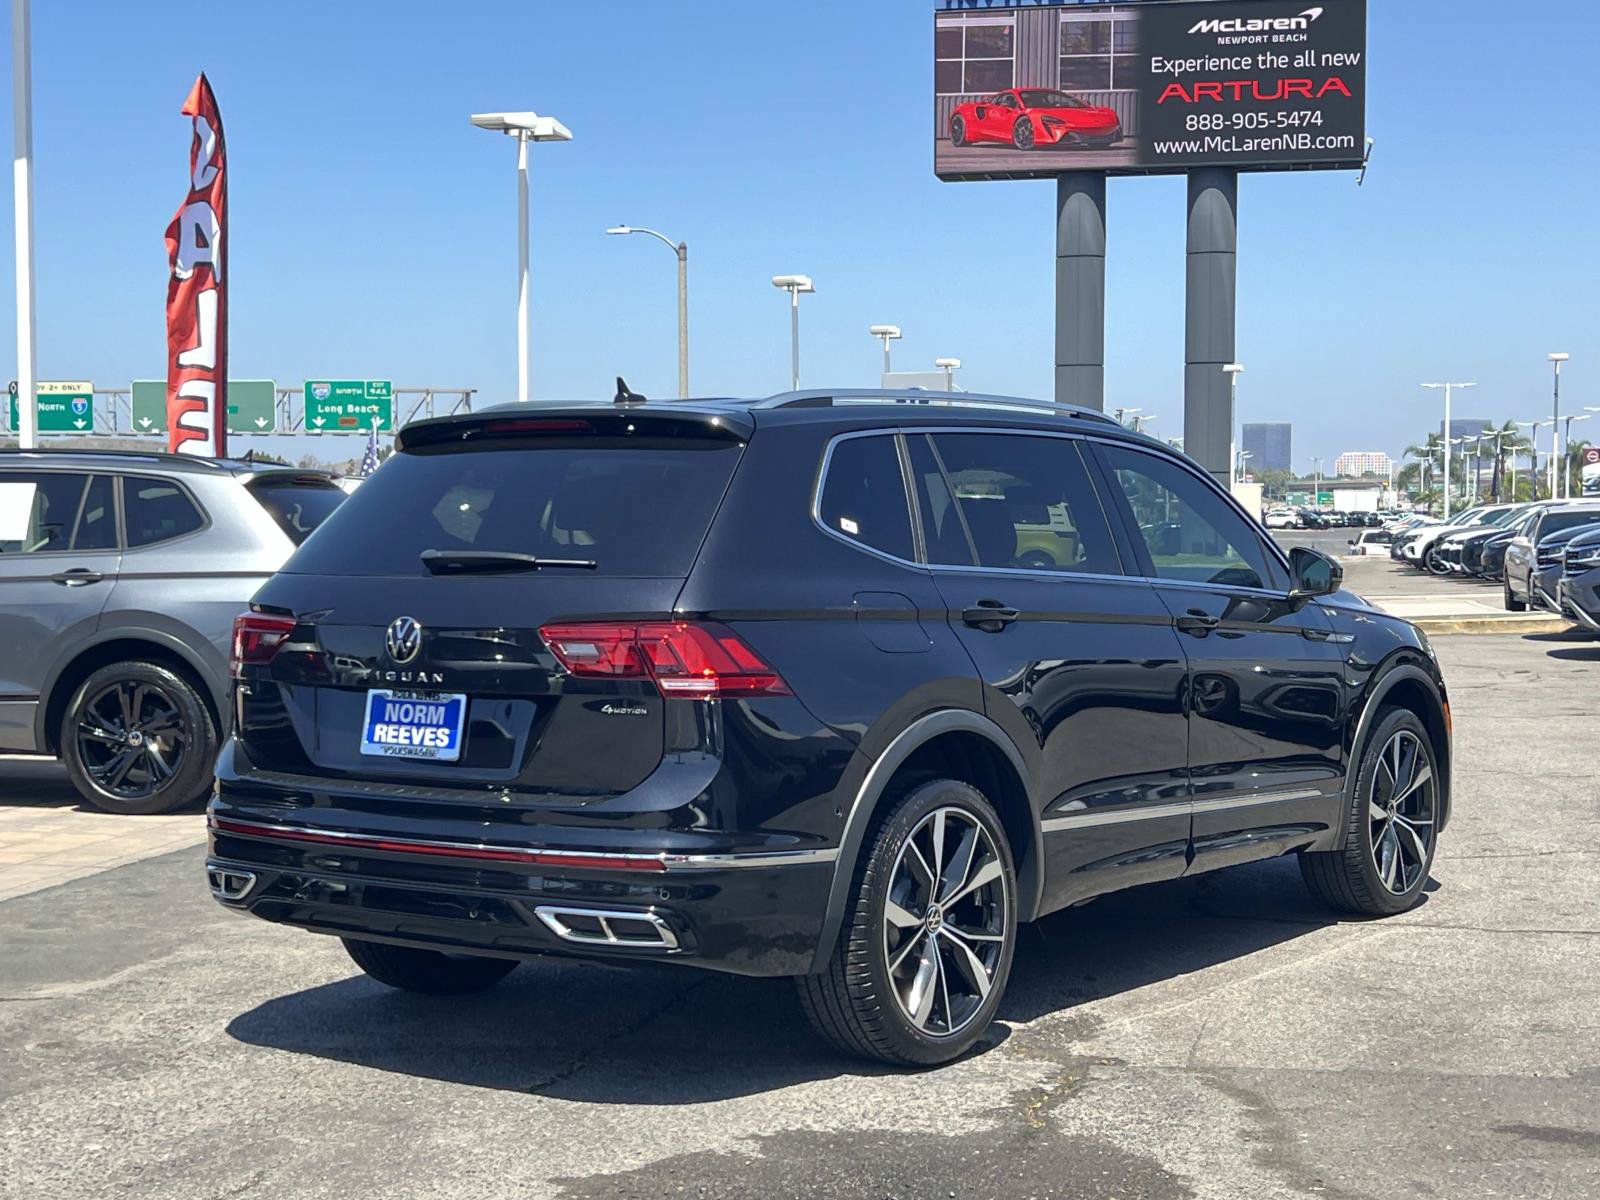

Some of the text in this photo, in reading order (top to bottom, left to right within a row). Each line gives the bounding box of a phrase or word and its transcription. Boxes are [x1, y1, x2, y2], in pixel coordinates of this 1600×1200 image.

[1187, 16, 1308, 34] McLaren
[1217, 34, 1308, 45] NEWPORT BEACH
[1151, 50, 1361, 77] Experience the all new
[1156, 77, 1352, 104] ARTURA
[1185, 110, 1323, 131] 888-905-5474
[1153, 133, 1355, 154] www.McLarenNB.com
[317, 404, 343, 415] Long
[384, 702, 446, 726] NORM
[373, 723, 451, 748] REEVES
